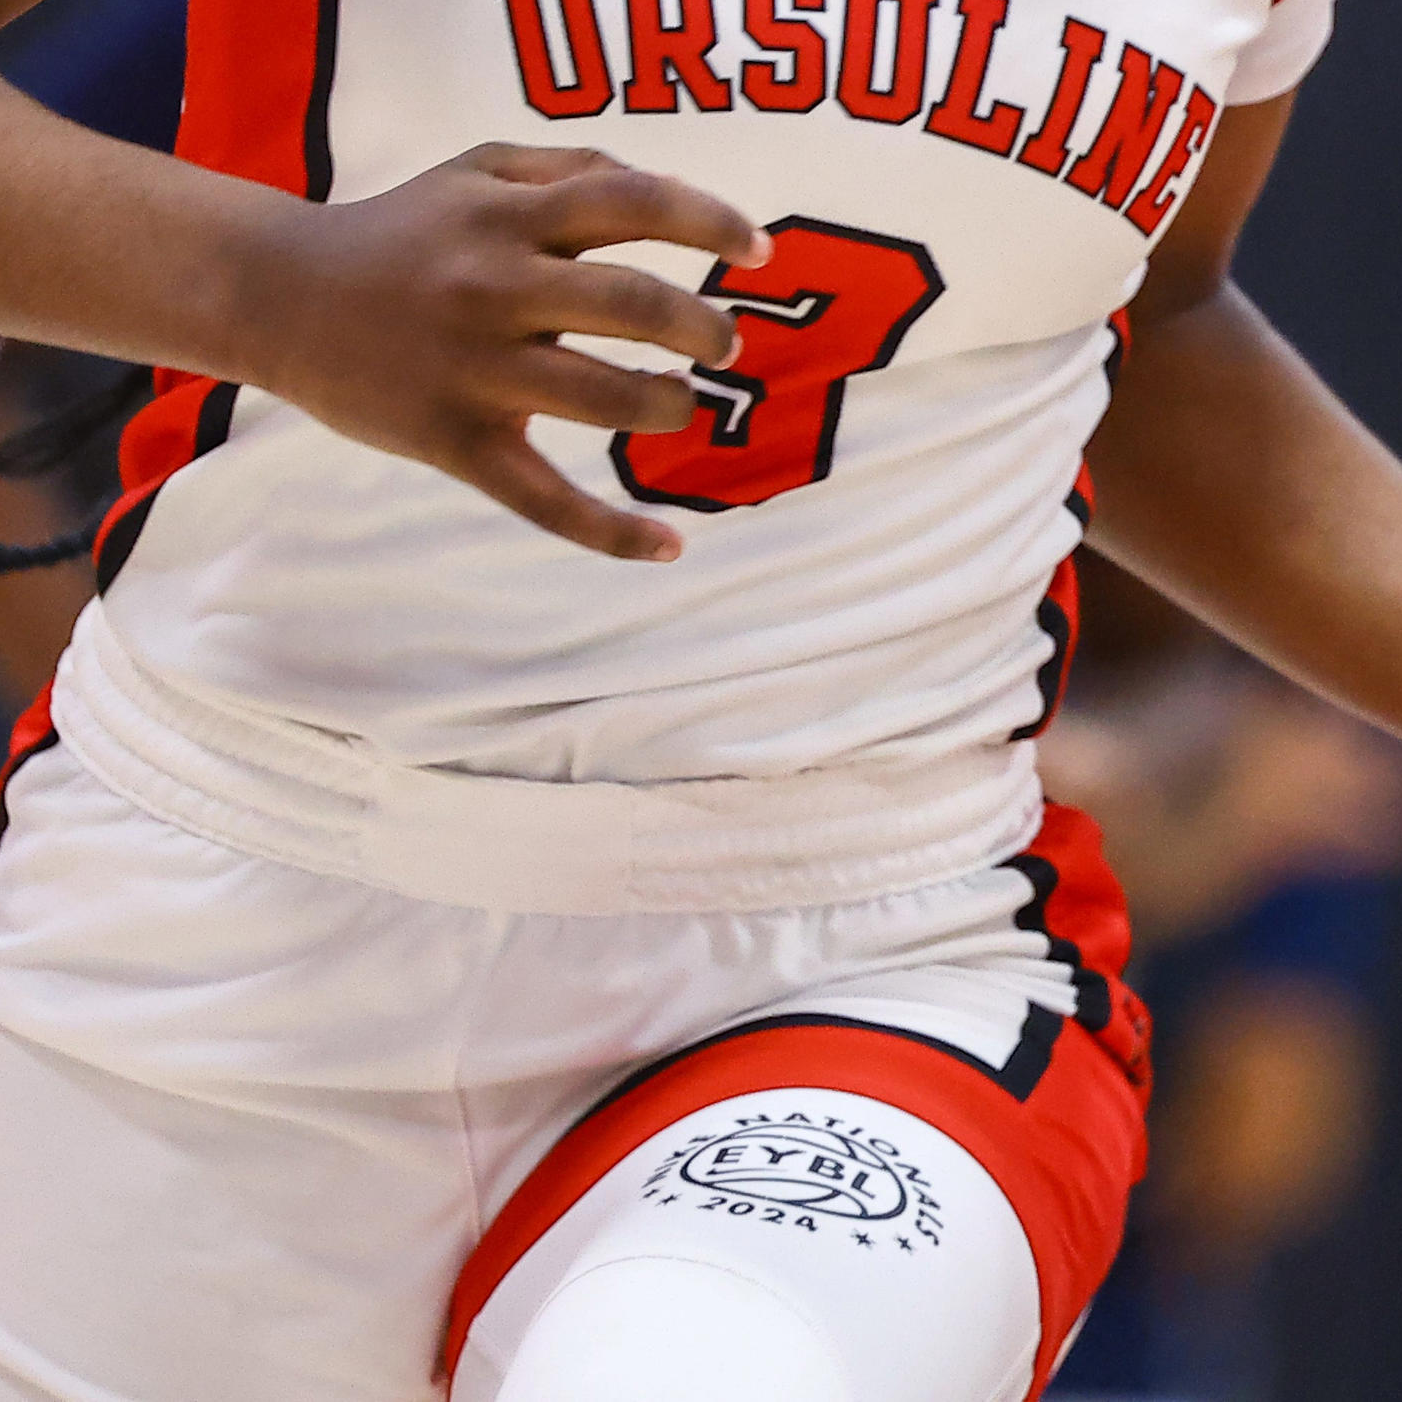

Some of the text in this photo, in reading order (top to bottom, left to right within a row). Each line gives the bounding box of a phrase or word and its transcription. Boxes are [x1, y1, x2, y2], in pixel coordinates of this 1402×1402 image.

[609, 214, 946, 513] 3
[712, 1144, 876, 1199] EYBL
[696, 1196, 819, 1232] 2024
